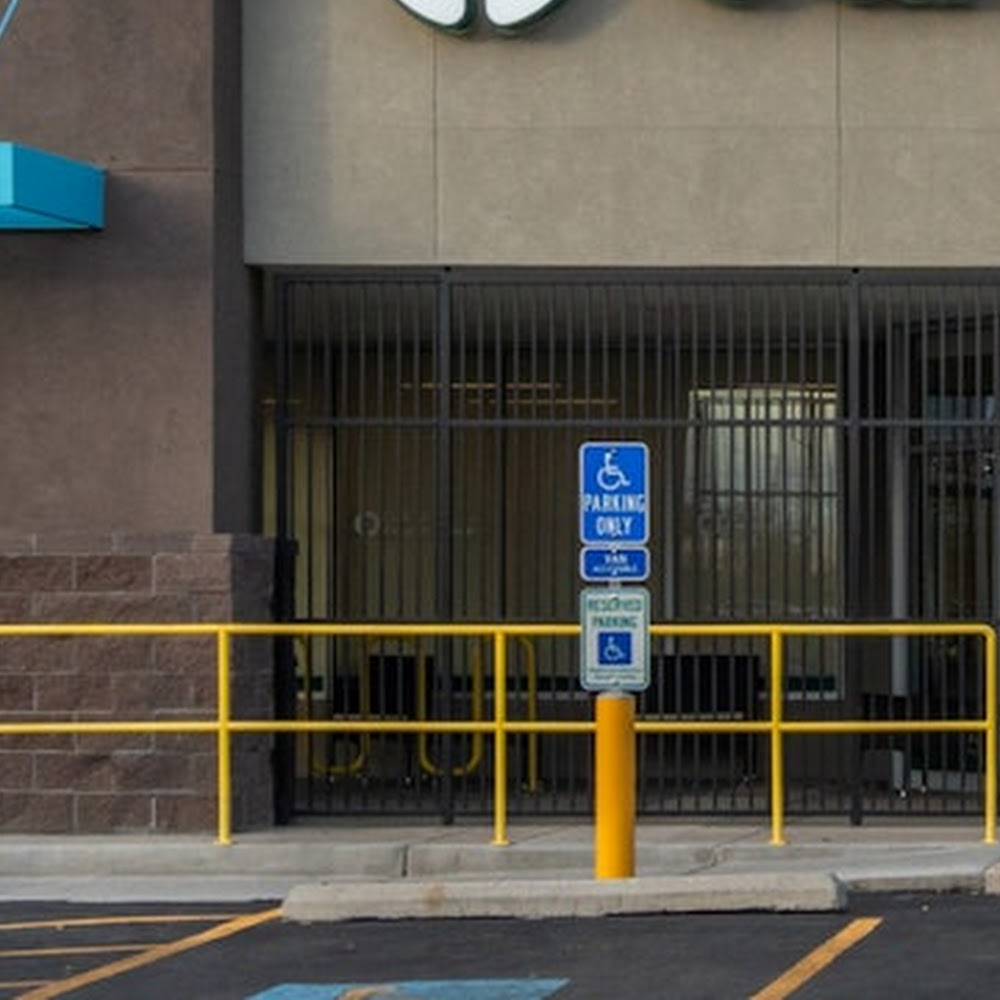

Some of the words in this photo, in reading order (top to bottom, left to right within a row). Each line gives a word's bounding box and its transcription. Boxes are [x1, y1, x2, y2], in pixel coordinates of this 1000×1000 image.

[580, 494, 647, 512] PARKING
[596, 516, 632, 536] ONLY
[592, 616, 637, 628] PARKING
